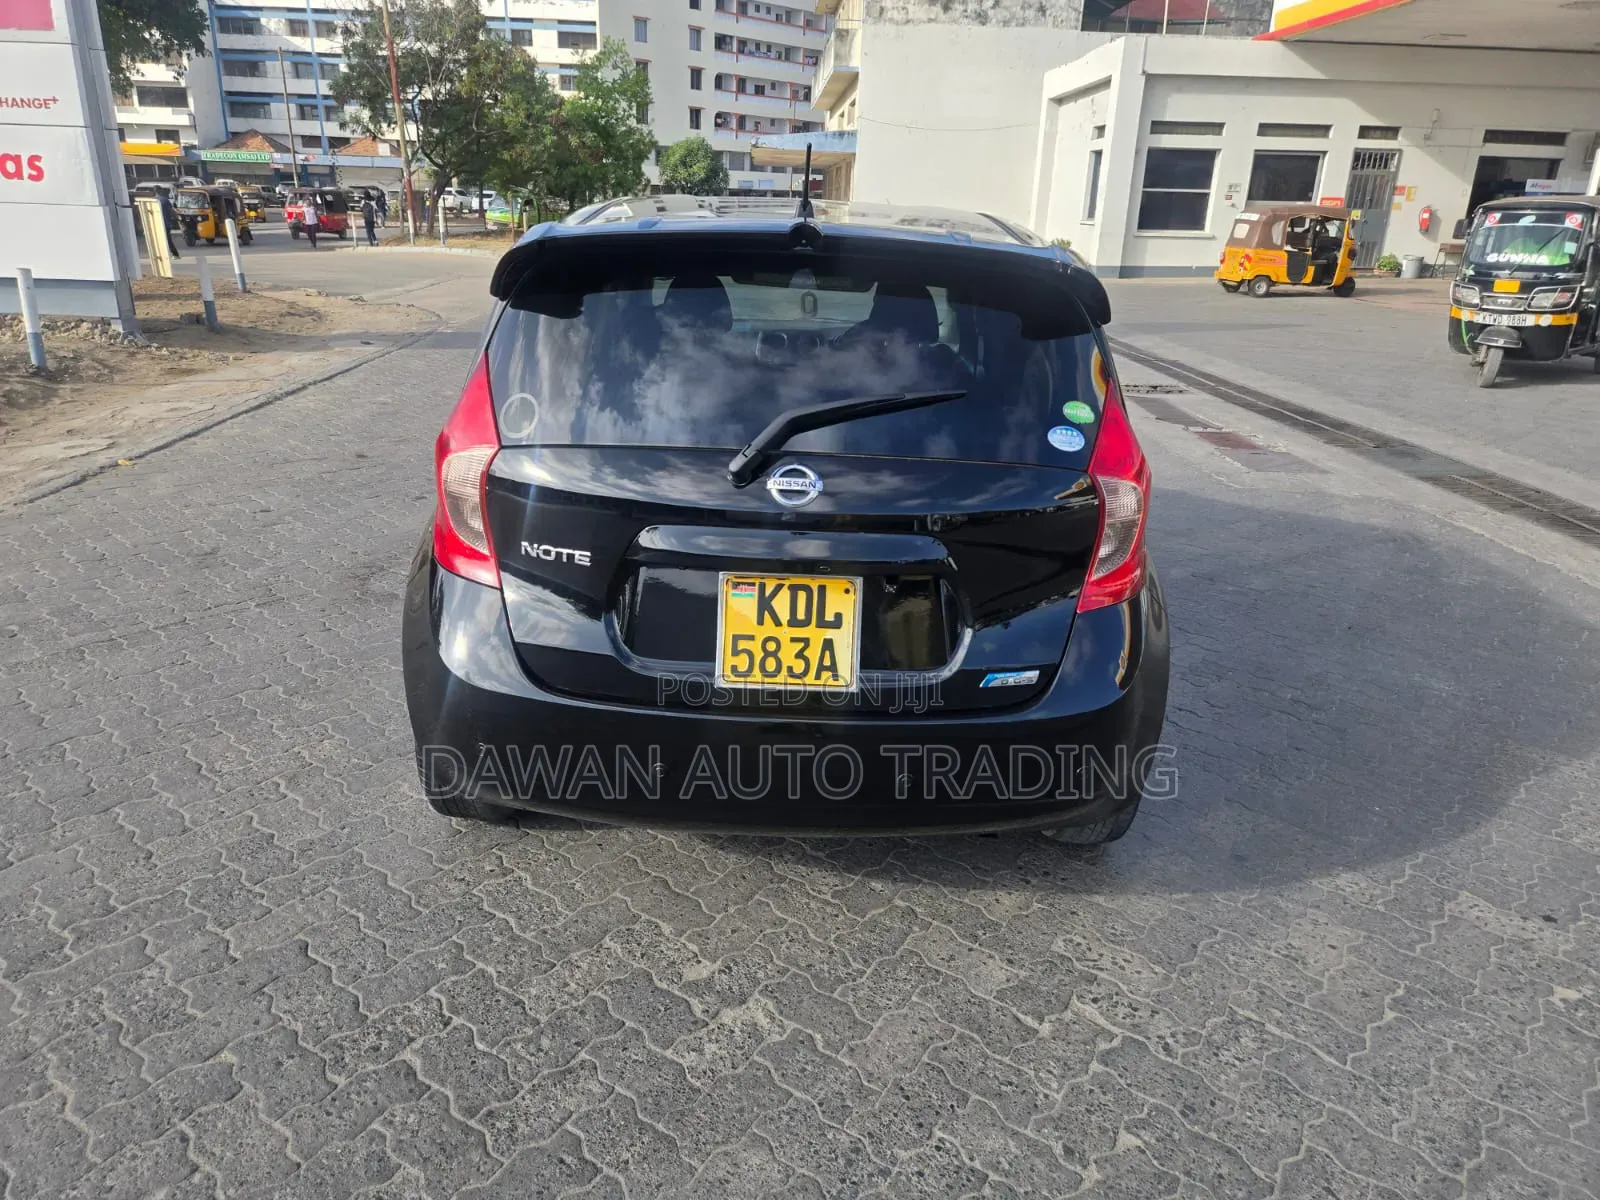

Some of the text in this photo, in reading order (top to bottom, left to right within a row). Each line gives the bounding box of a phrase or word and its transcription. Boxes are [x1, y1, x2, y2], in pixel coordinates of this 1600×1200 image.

[773, 480, 816, 489] NISSAN
[520, 541, 592, 566] NOTE
[756, 581, 843, 629] KDL
[730, 634, 839, 681] 583A
